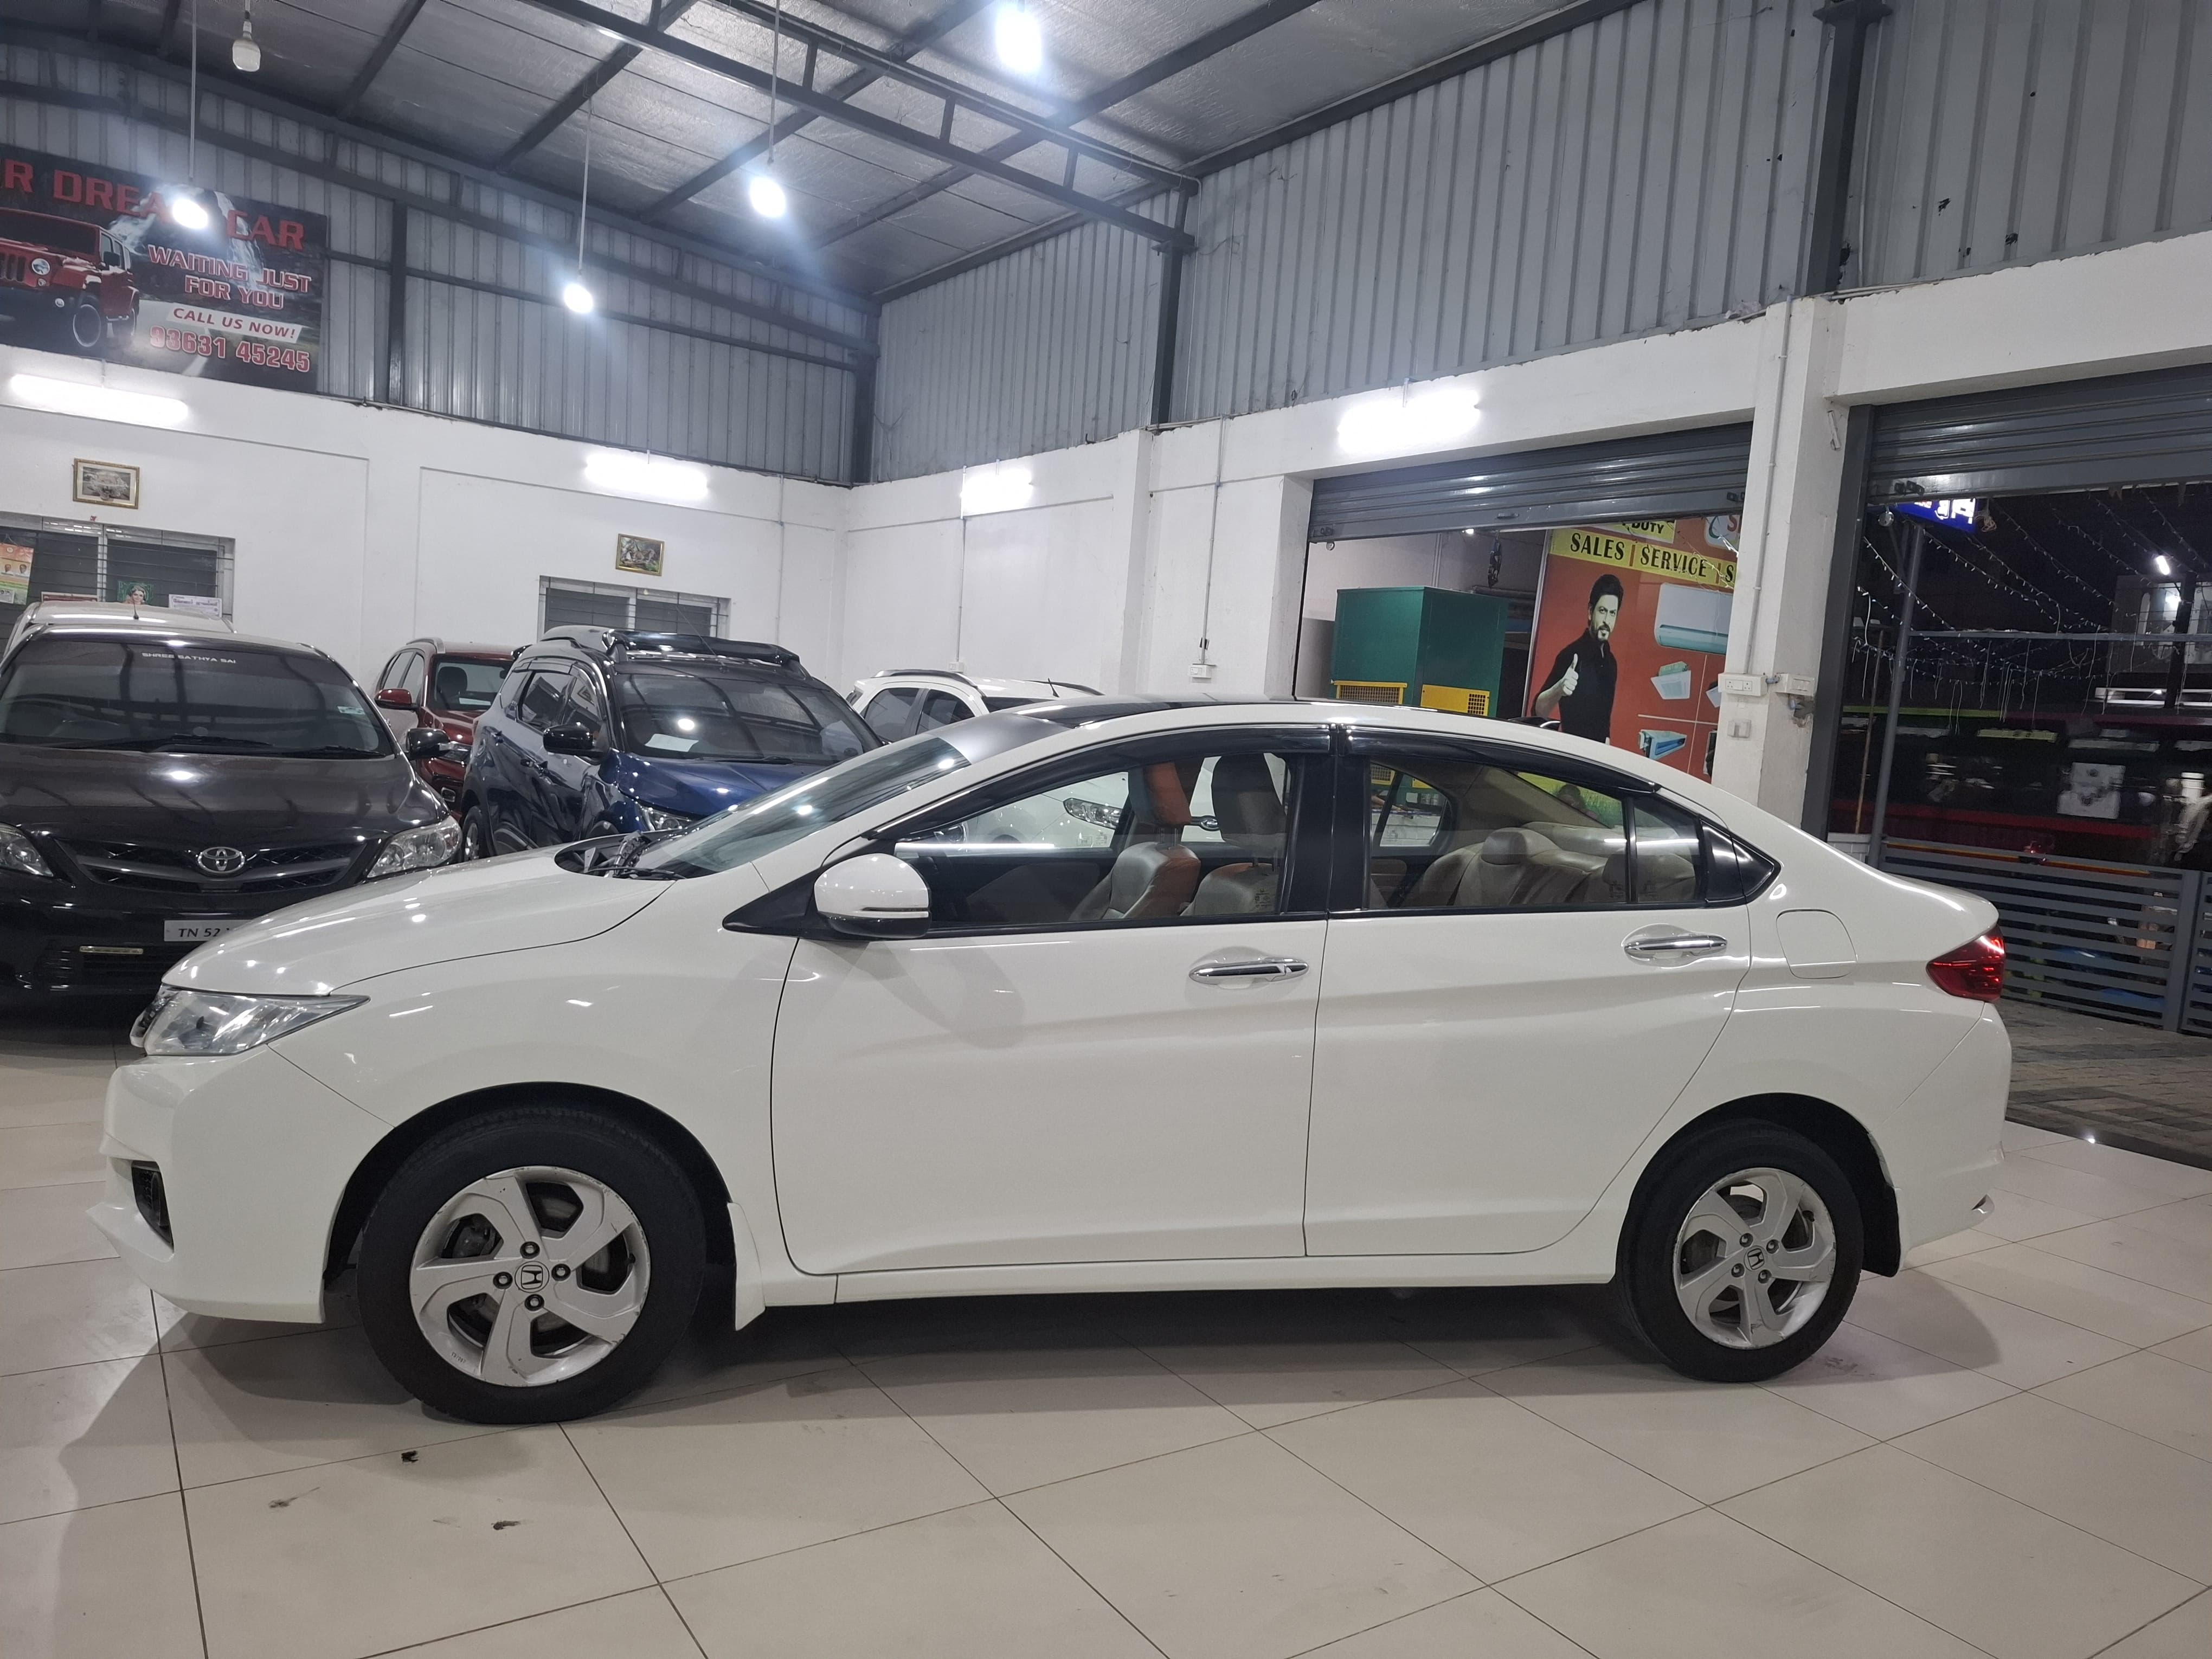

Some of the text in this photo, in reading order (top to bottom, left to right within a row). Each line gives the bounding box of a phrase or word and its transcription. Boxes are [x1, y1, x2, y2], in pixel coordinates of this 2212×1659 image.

[53, 170, 187, 224] DREA
[227, 210, 305, 250] CAR
[148, 245, 312, 293] WAITING JUST
[185, 275, 284, 310] FOR YOU
[173, 308, 295, 338] CALL US NOW!
[150, 325, 310, 372] 93631 45245
[1571, 532, 1625, 561] SALES
[1641, 545, 1708, 577] SERVICE
[178, 928, 221, 937] TN 52
